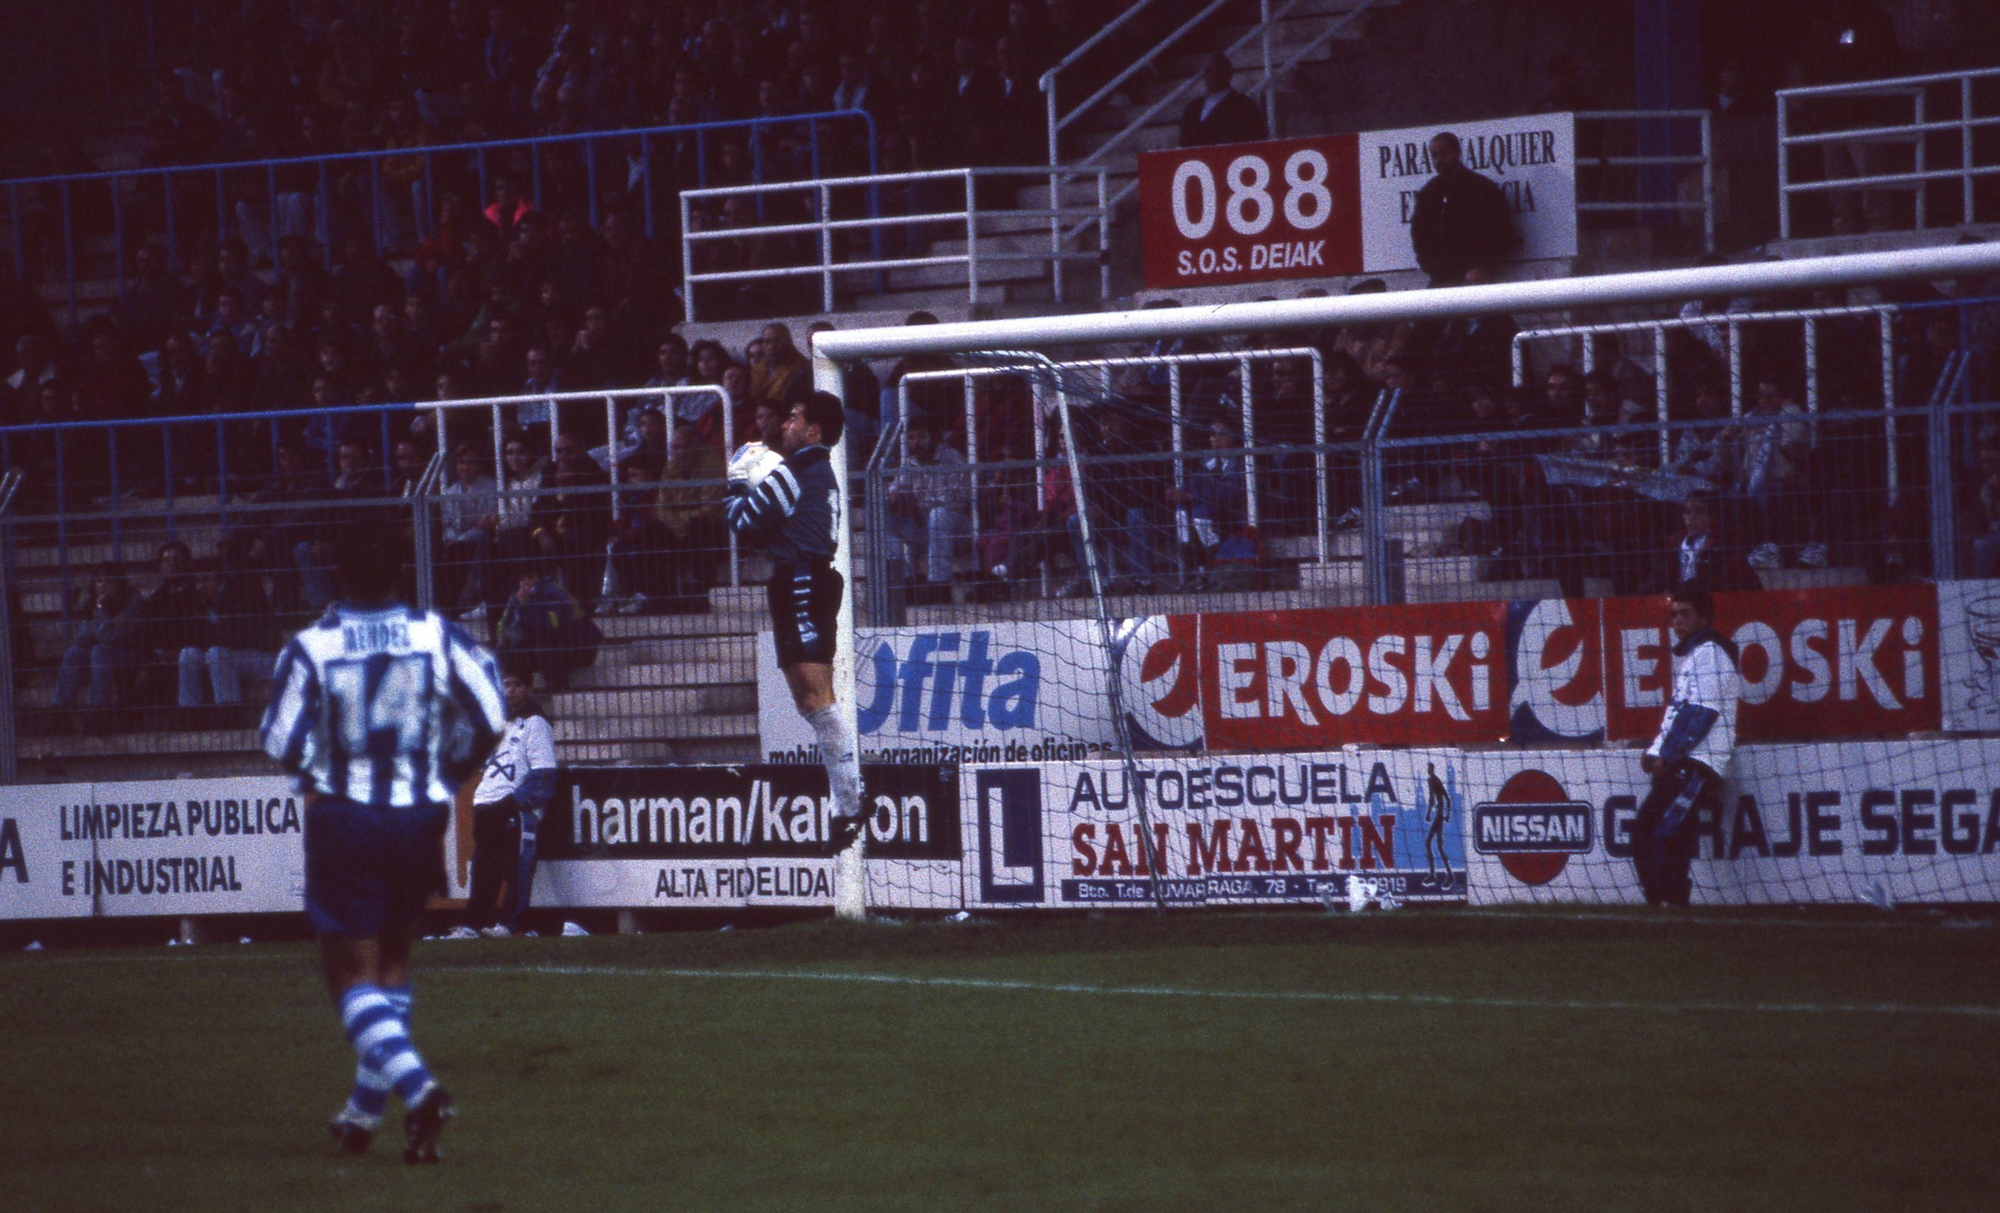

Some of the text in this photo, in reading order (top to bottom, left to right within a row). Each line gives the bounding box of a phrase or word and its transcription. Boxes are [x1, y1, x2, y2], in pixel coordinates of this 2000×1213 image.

[1459, 130, 1556, 174] ALQUIER
[1171, 149, 1332, 239] 088
[1177, 240, 1326, 276] S.O.S. DEIAK
[326, 655, 428, 752] 14
[1005, 739, 1027, 762] de
[1068, 762, 1398, 812] AUTOESCUELA
[60, 798, 301, 841] LIMPIEZA PUBLICA
[572, 779, 929, 845] harman/karon
[1480, 813, 1586, 843] NISSAN
[1603, 790, 1843, 860] GRAJE
[1071, 813, 1396, 877] SAN MARTIN
[62, 856, 242, 896] E INDUSTRIAL
[655, 866, 835, 899] ALTA FIDELIDA
